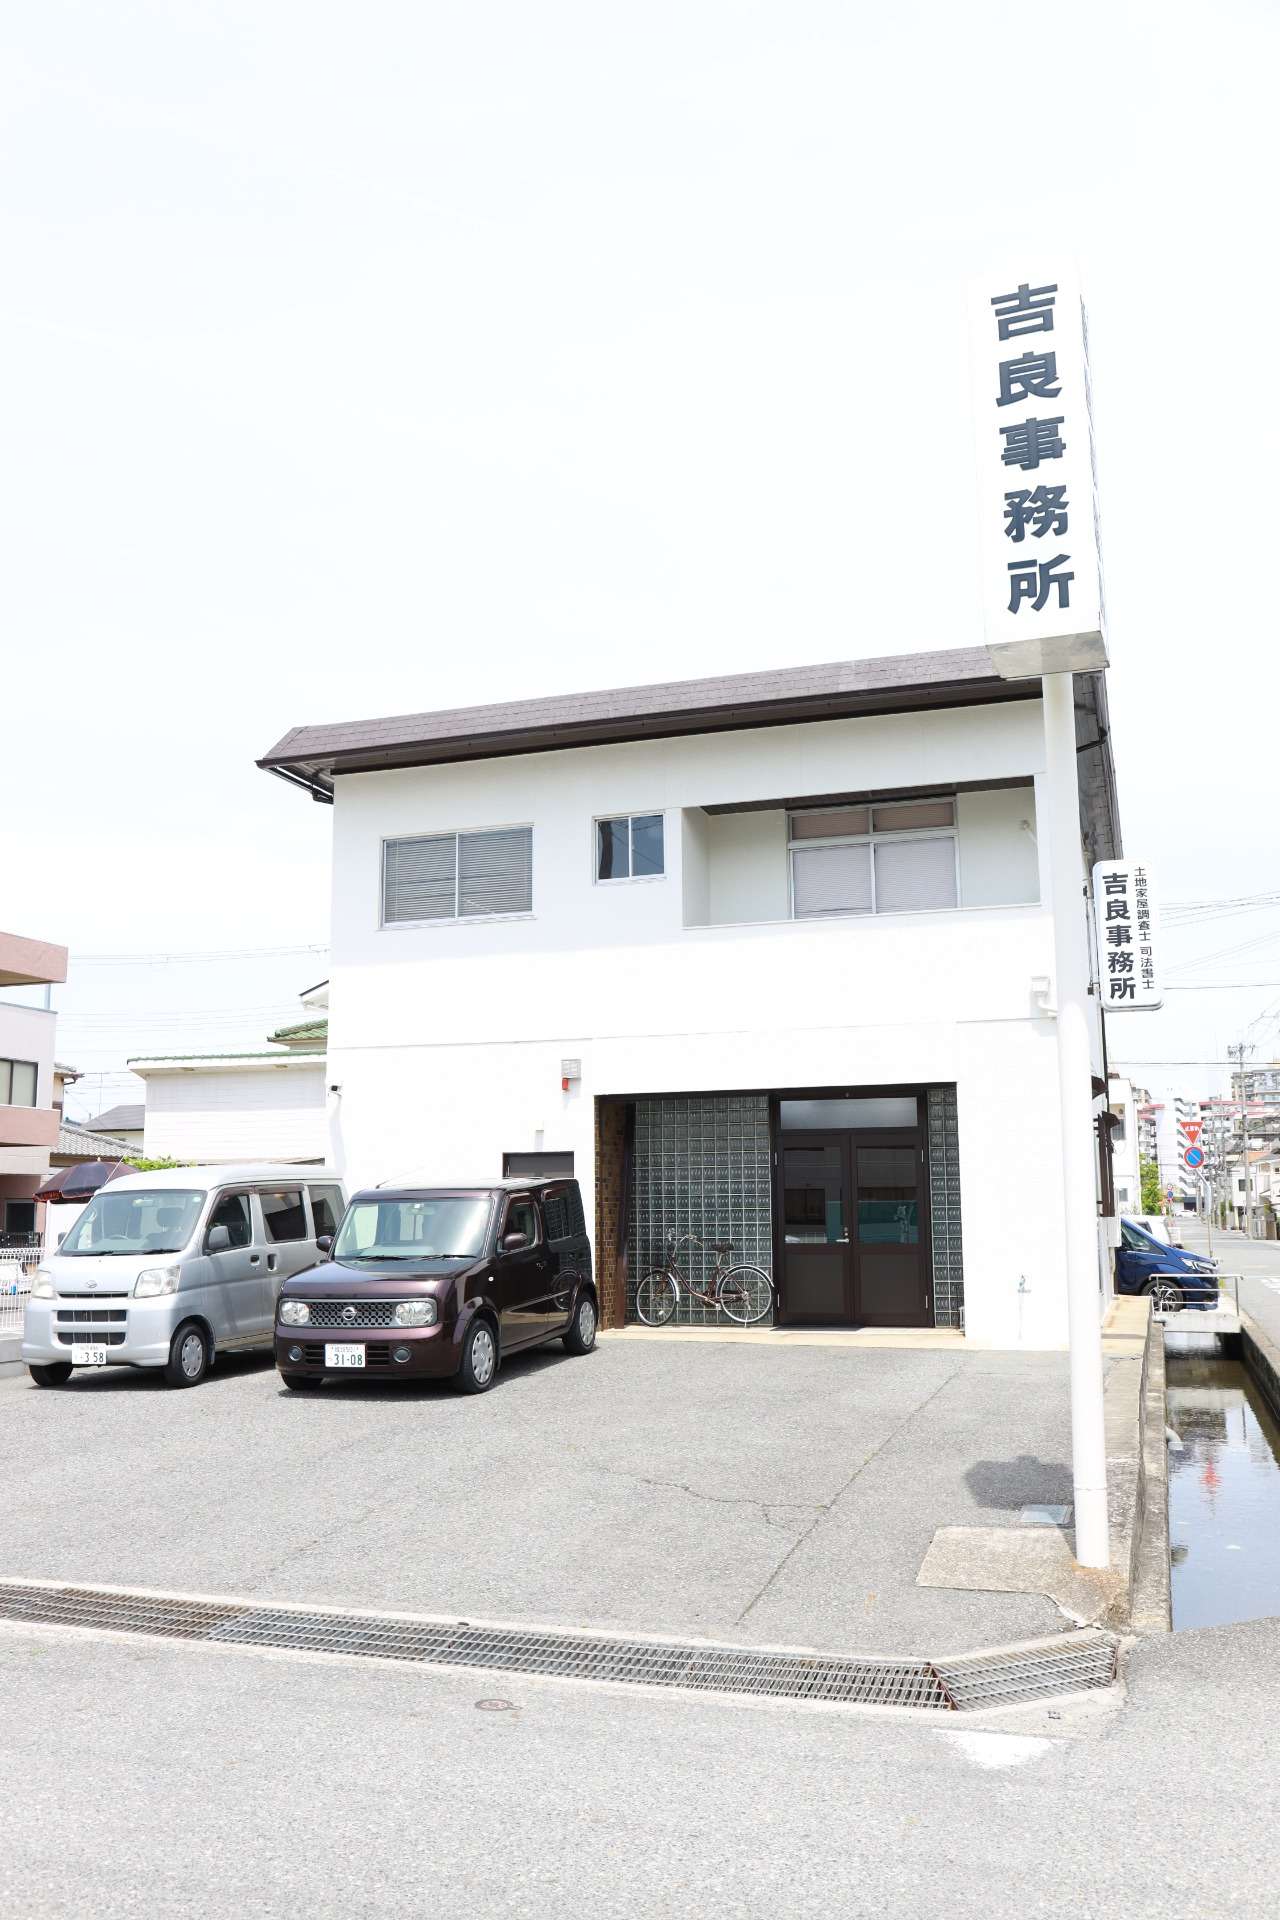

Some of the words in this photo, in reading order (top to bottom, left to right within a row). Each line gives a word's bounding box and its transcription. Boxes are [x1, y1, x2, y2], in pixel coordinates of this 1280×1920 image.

[991, 284, 1074, 615] 吉良事務所
[1102, 873, 1137, 1000] 吉良事務所
[1134, 867, 1151, 941] 土地家屋調査士
